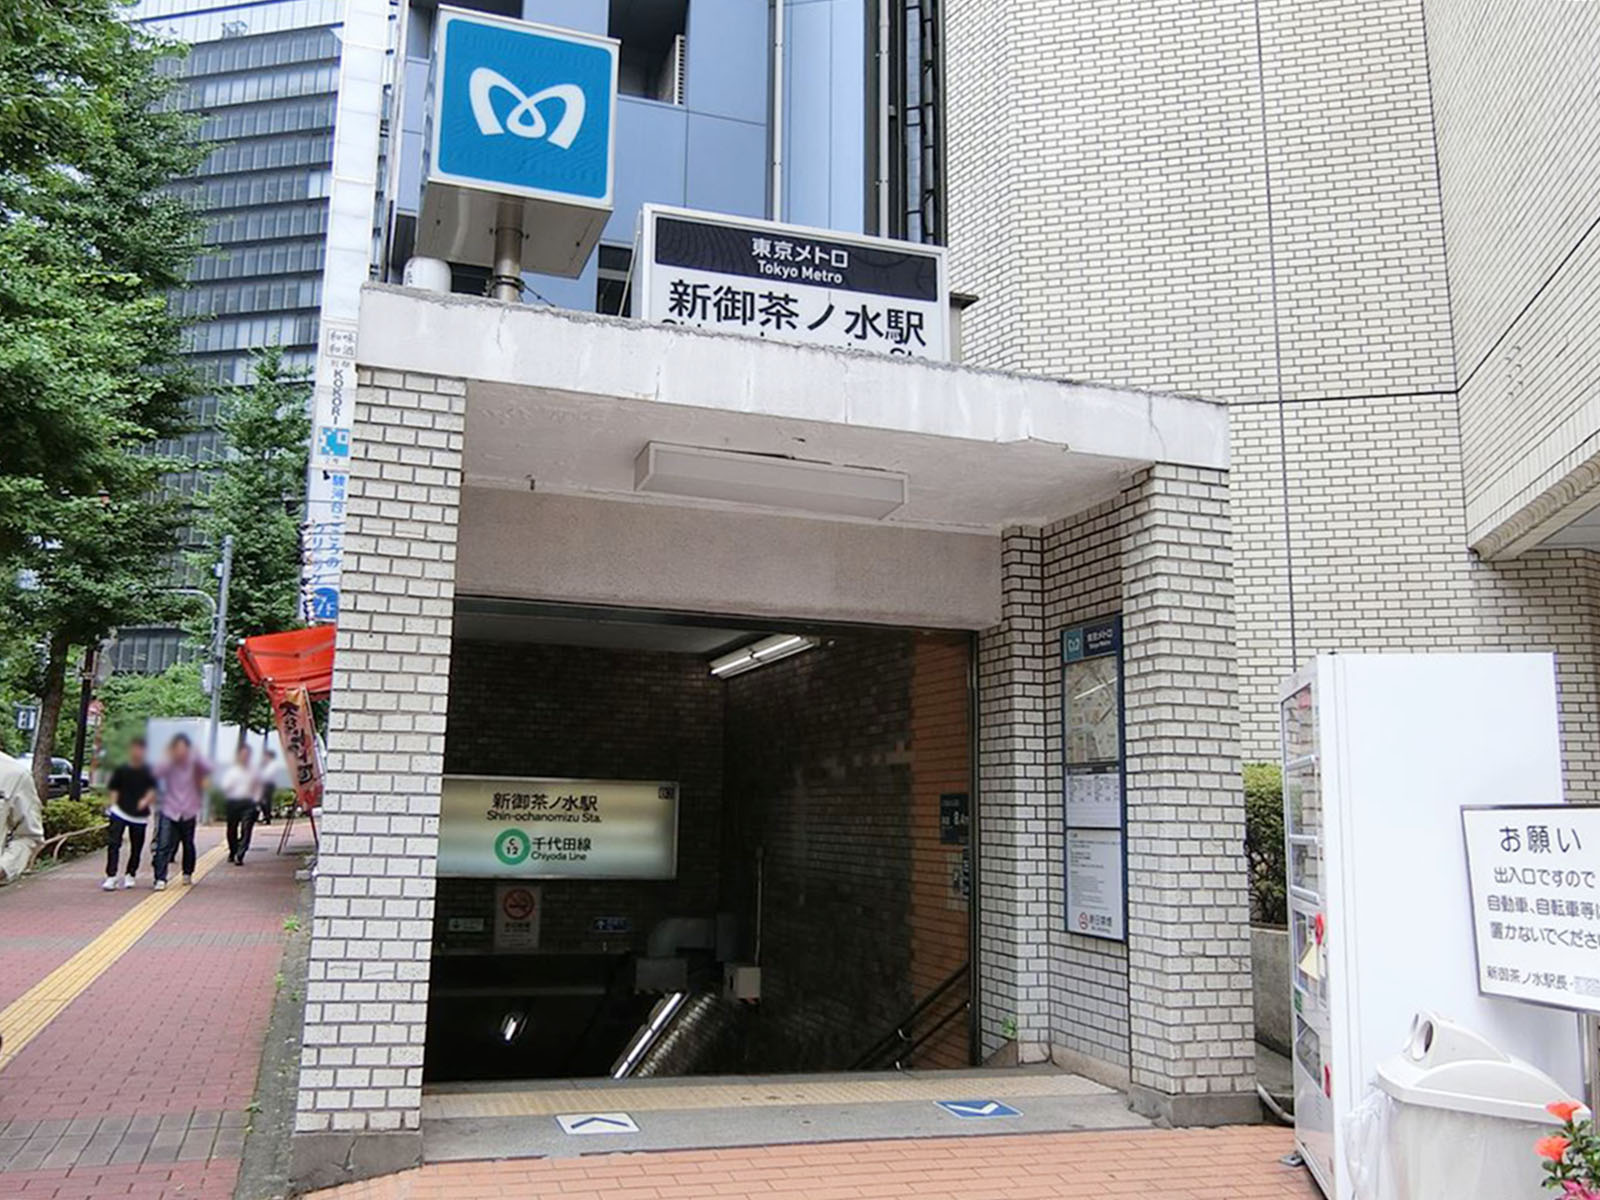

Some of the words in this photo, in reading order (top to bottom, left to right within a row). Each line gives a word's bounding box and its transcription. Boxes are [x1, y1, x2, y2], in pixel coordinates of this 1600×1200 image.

[752, 238, 848, 268] 東京メトロ
[757, 260, 799, 279] Tokyo
[801, 267, 843, 284] Metro
[669, 279, 926, 346] 新御茶ノ水駅
[331, 369, 344, 425] KOKORI
[315, 594, 336, 618] 7F
[492, 792, 598, 811] 新御茶ノ水駅
[486, 810, 580, 823] Shin-ochanomizu
[582, 813, 602, 823] Sta.
[506, 846, 519, 855] 12
[508, 838, 515, 846] C
[532, 837, 592, 851] 千代田線
[1499, 825, 1581, 853] お願い
[531, 851, 567, 861] Chiyoda
[569, 852, 587, 861] Line
[1494, 866, 1596, 889] 出入口ですので
[1490, 921, 1600, 950] 置かないでくださ
